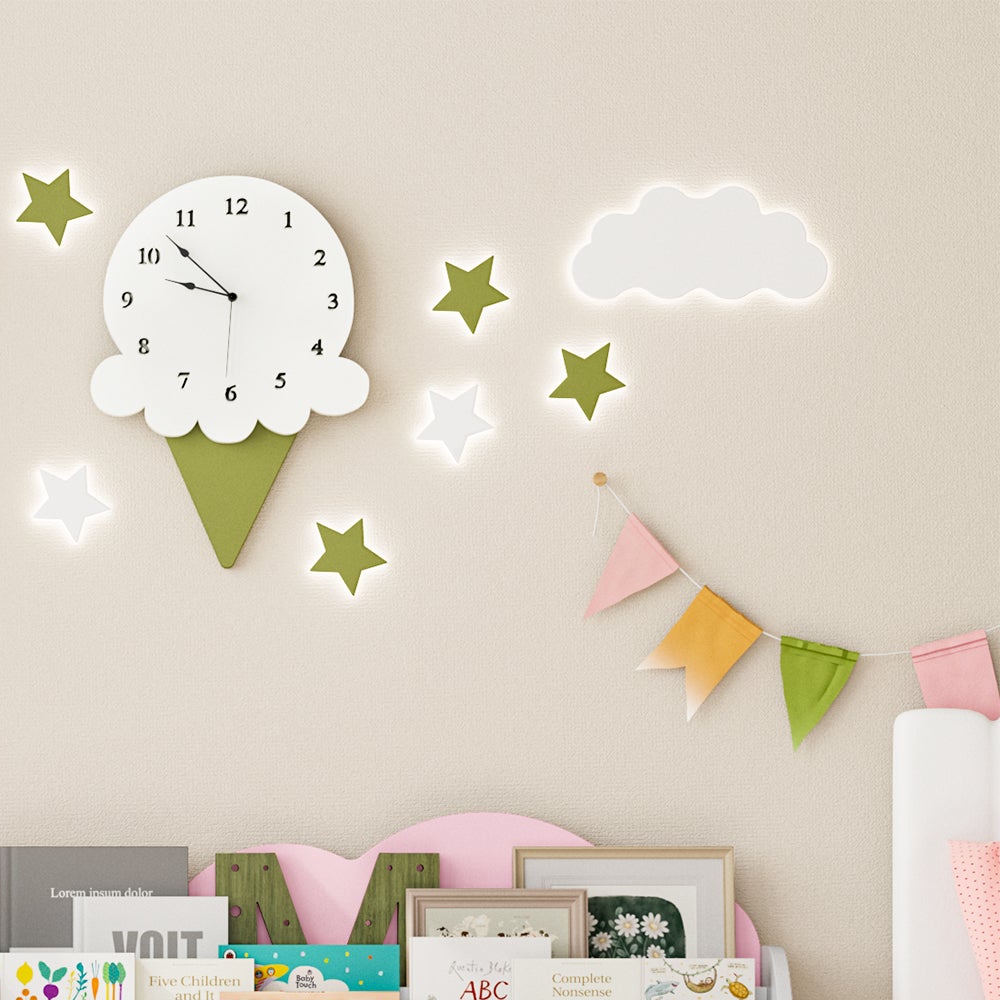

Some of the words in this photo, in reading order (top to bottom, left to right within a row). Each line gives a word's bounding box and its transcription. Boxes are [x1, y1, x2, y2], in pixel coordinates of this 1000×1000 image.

[225, 198, 248, 215] 12
[176, 210, 196, 227] 11
[284, 211, 293, 228] 1
[139, 248, 160, 265] 10
[313, 249, 327, 266] 2
[121, 292, 133, 308] 9
[327, 293, 339, 310] 3
[138, 338, 150, 354] 8
[311, 339, 323, 355] 4
[177, 372, 190, 389] 7
[275, 372, 287, 389] 5
[225, 385, 238, 401] 6
[50, 888, 86, 898] Lorem
[124, 887, 153, 897] dolor
[149, 976, 178, 987] Five
[180, 976, 241, 987] Children
[296, 975, 314, 984] Baby
[552, 973, 612, 986] Complete
[175, 990, 201, 1000] and
[206, 990, 215, 1000] It
[552, 987, 612, 998] Nonsense
